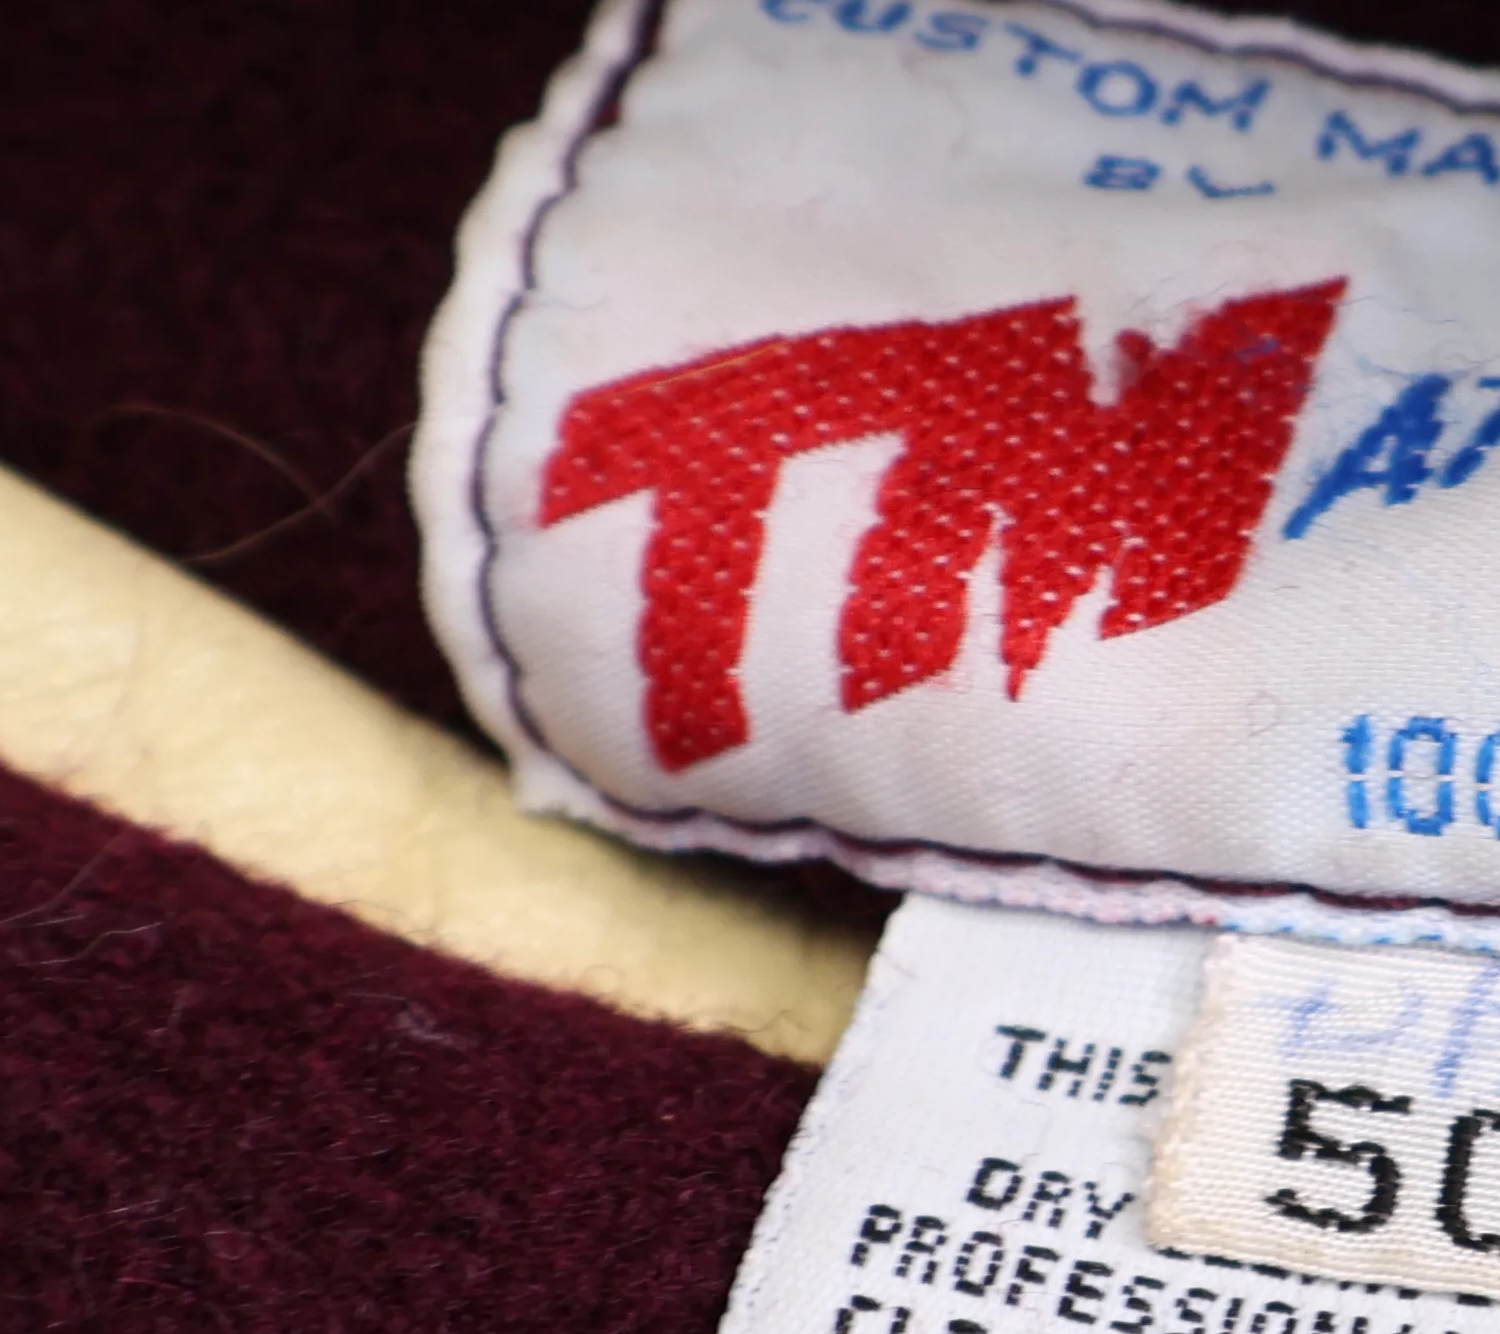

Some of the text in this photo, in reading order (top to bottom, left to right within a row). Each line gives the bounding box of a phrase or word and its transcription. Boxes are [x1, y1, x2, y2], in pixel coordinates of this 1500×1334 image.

[536, 275, 1349, 773] TM
[995, 1024, 1173, 1107] THIS
[966, 1156, 1136, 1239] DRY
